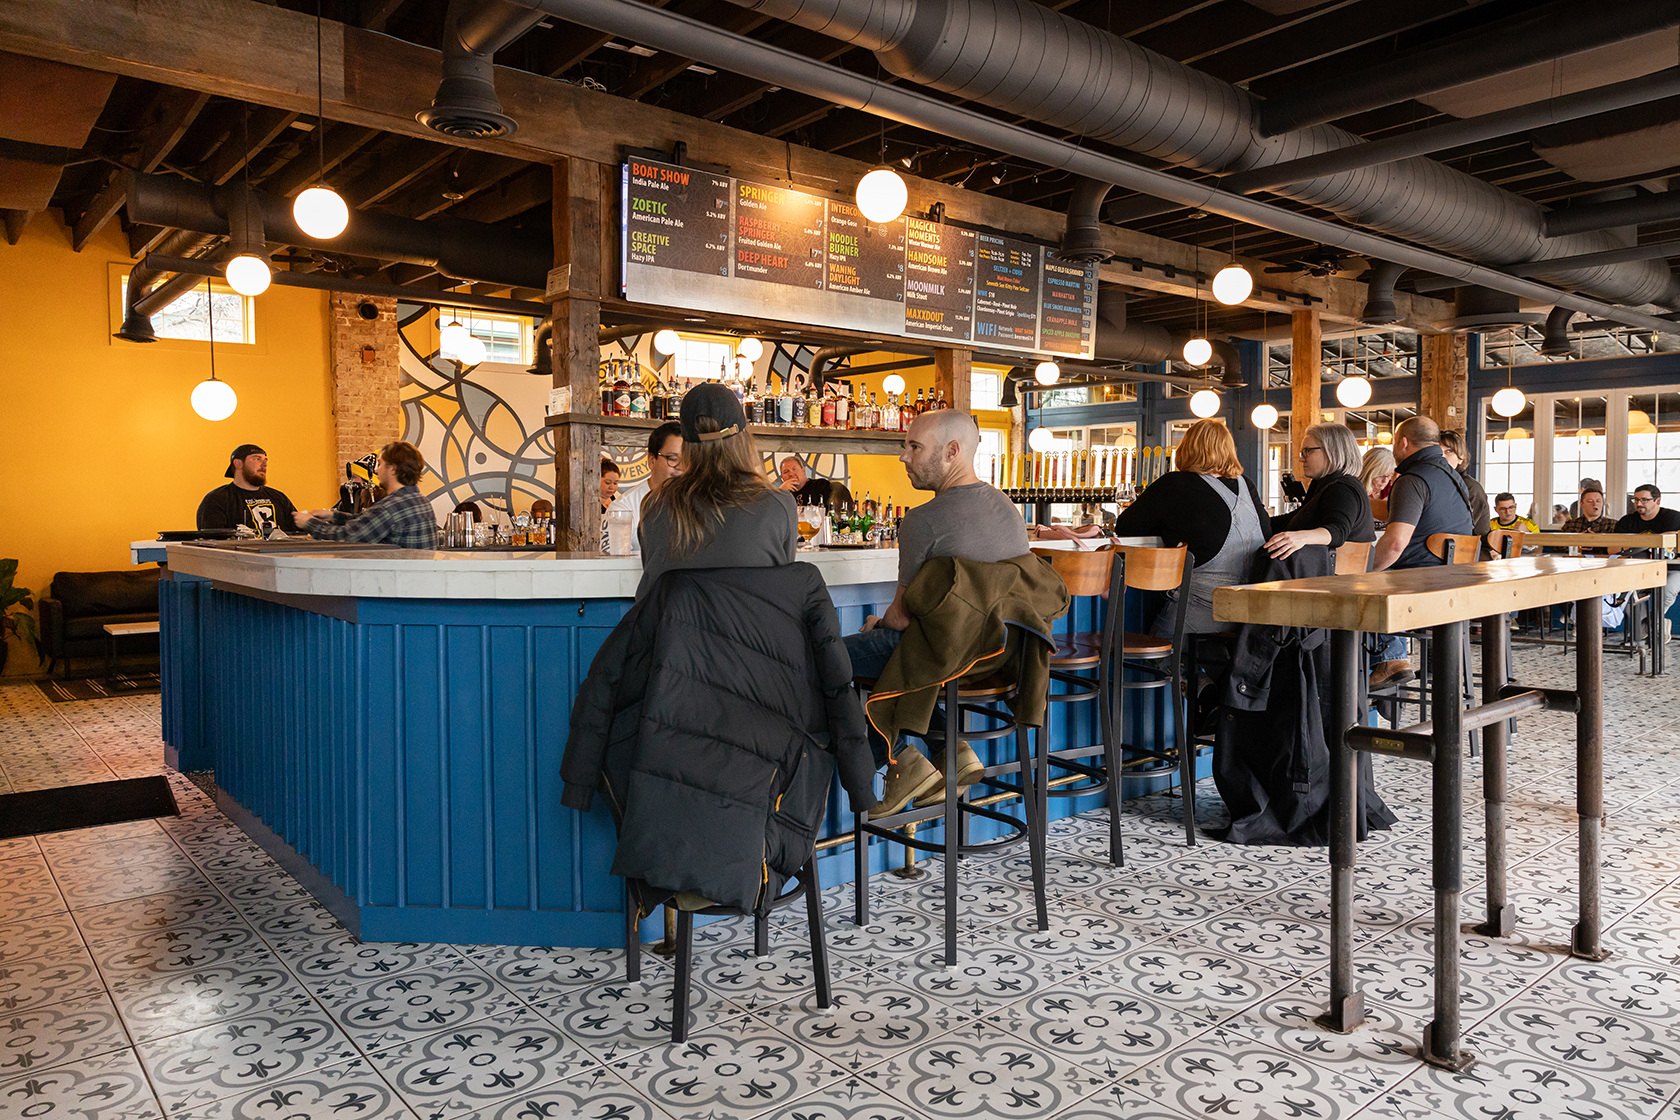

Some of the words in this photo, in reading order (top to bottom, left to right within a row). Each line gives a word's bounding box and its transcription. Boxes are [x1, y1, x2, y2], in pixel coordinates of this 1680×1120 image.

[632, 163, 658, 179] BOAT
[660, 169, 690, 186] SHOW
[632, 177, 647, 187] India
[648, 180, 659, 189] Pale
[660, 182, 669, 191] Ale
[740, 185, 785, 205] SPRINGER
[632, 197, 667, 215] ZOETIC
[740, 198, 759, 209] Golden
[759, 202, 767, 211] Ale
[831, 203, 858, 217] INTERCO
[632, 212, 660, 224] American
[661, 216, 673, 226] Pale
[674, 219, 684, 228] Ale
[740, 216, 780, 232] RASPBERRY
[831, 216, 847, 227] Orange
[909, 220, 937, 234] MAGICAL
[632, 231, 670, 247] CREATIVE
[739, 226, 775, 241] SPRINGER
[830, 232, 858, 247] NOODLE
[909, 229, 940, 244] MOMENTS
[632, 242, 656, 255] SPACE
[738, 236, 756, 246] Fruited
[756, 240, 773, 249] Golden
[829, 243, 859, 257] BURNER
[631, 253, 645, 263] Hazy
[645, 255, 655, 263] IPA
[738, 250, 760, 264] DEEP
[761, 253, 788, 269] HEART
[908, 250, 947, 267] HANDSOME
[738, 264, 768, 274] Dortmunder
[830, 263, 856, 276] WANING
[908, 262, 927, 272] American
[928, 266, 940, 274] Brown
[830, 273, 860, 286] DAYLIGHT
[829, 283, 848, 292] American
[908, 280, 945, 295] MOONMILK
[907, 291, 916, 299] Milk
[906, 308, 944, 322] MAXXDOUT
[906, 320, 924, 329] American
[925, 323, 942, 331] Imperial
[977, 322, 997, 336] WIFI
[619, 460, 649, 478] WERY
